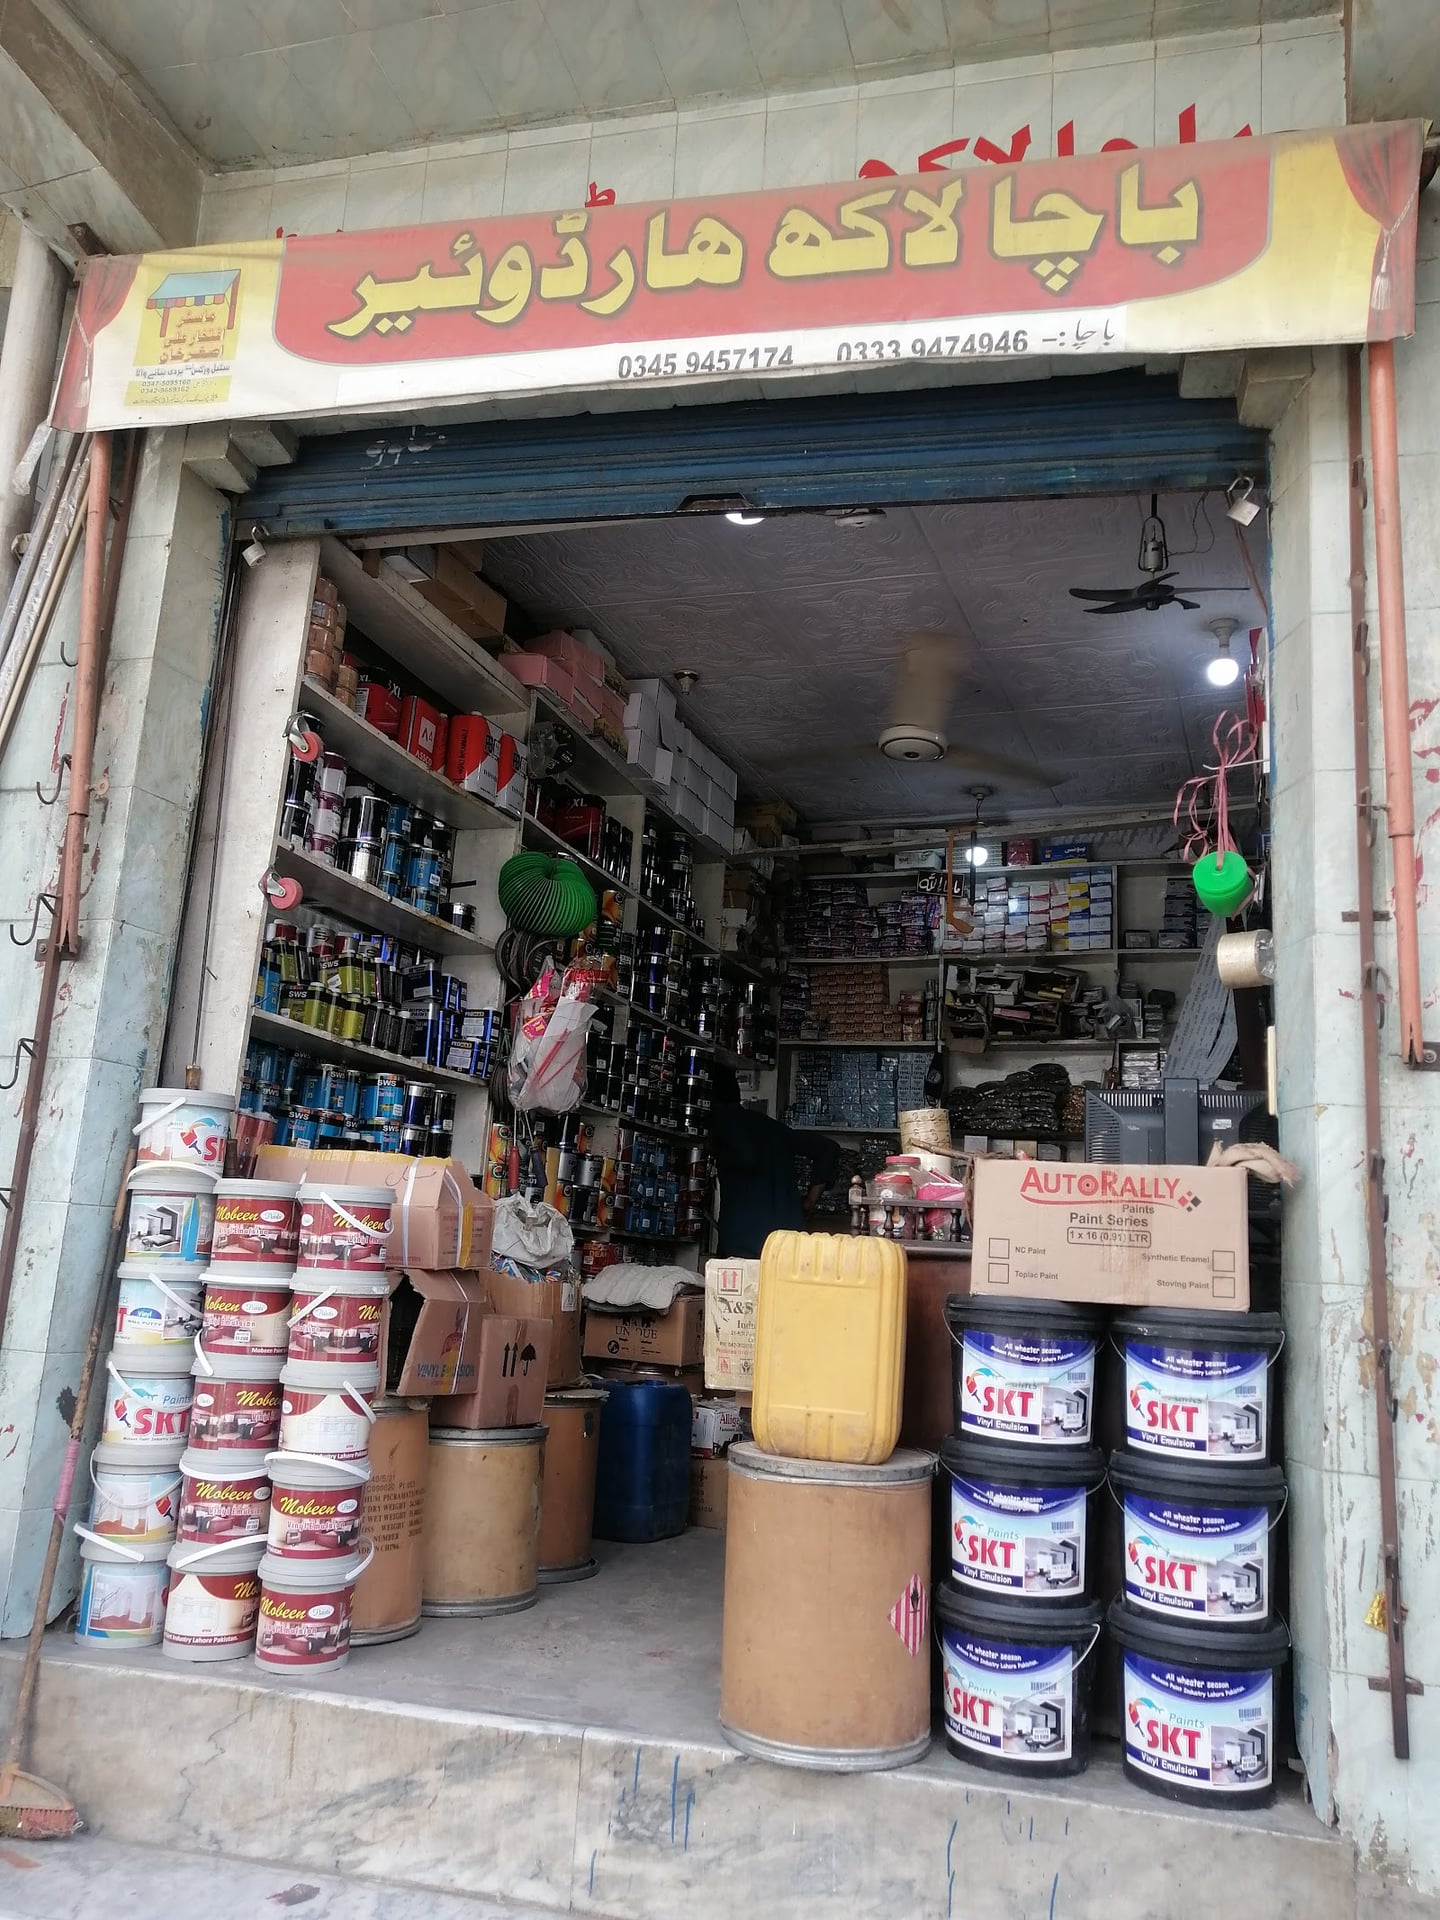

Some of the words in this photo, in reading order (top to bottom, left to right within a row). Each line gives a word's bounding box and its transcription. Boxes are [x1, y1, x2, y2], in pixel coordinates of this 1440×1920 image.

[769, 178, 964, 277] لاکھ
[993, 162, 1199, 292] باچا
[618, 354, 677, 379] 0345
[686, 345, 794, 374] 9457174
[837, 338, 901, 362] 0333
[911, 330, 1028, 357] 9474946
[288, 990, 308, 999] SWS
[377, 1079, 397, 1087] SWS
[289, 1111, 309, 1121] SWS
[216, 1205, 260, 1221] Mobeen
[1122, 1204, 1155, 1215] Paints
[1070, 1212, 1103, 1225] Paint
[1107, 1214, 1149, 1227] Series
[1086, 1231, 1098, 1241] 16
[1129, 1233, 1149, 1243] LTR
[1015, 1246, 1026, 1254] NC
[1028, 1246, 1046, 1255] Paint
[1142, 1252, 1178, 1264] Synthetic
[1180, 1254, 1210, 1264] Enamel
[1039, 1271, 1059, 1281] Paint
[1157, 1279, 1187, 1290] Stoving
[1189, 1280, 1210, 1290] Paint
[1020, 1354, 1040, 1363] Industry
[1183, 1366, 1204, 1376] Industry
[984, 1386, 1033, 1417] SKT
[1147, 1401, 1198, 1432] SKT
[977, 1417, 993, 1428] Vinyl
[996, 1421, 1029, 1433] Emulsion
[1142, 1432, 1158, 1443] Vinyl
[1161, 1436, 1195, 1448] Emulsion
[196, 1482, 252, 1501] Mobeen
[280, 1496, 336, 1516] Mobeen
[383, 1502, 406, 1511] WEIGHT
[383, 1511, 406, 1521] WEIGHT
[381, 1522, 404, 1531] WEIGHT
[988, 1528, 1020, 1539] Paints
[1180, 1523, 1201, 1533] Industry
[969, 1535, 1016, 1568] SKT
[964, 1565, 977, 1578] Vinyl
[981, 1570, 1012, 1584] Emulsion
[1145, 1556, 1197, 1591] SKT
[1140, 1588, 1156, 1601] Vinyl
[1159, 1593, 1194, 1608] Emulsion
[261, 1596, 306, 1620] Mobeen
[173, 1634, 192, 1644] Industry
[193, 1636, 213, 1644] Lahore
[980, 1657, 999, 1668] Industry
[1184, 1686, 1205, 1698] Industry
[953, 1687, 994, 1726] SKT
[1169, 1713, 1204, 1728] Paints
[962, 1724, 990, 1743] Emulsion
[1147, 1720, 1201, 1759] SKT
[1142, 1752, 1158, 1766] Vinyl
[1162, 1759, 1198, 1776] Emulsion
